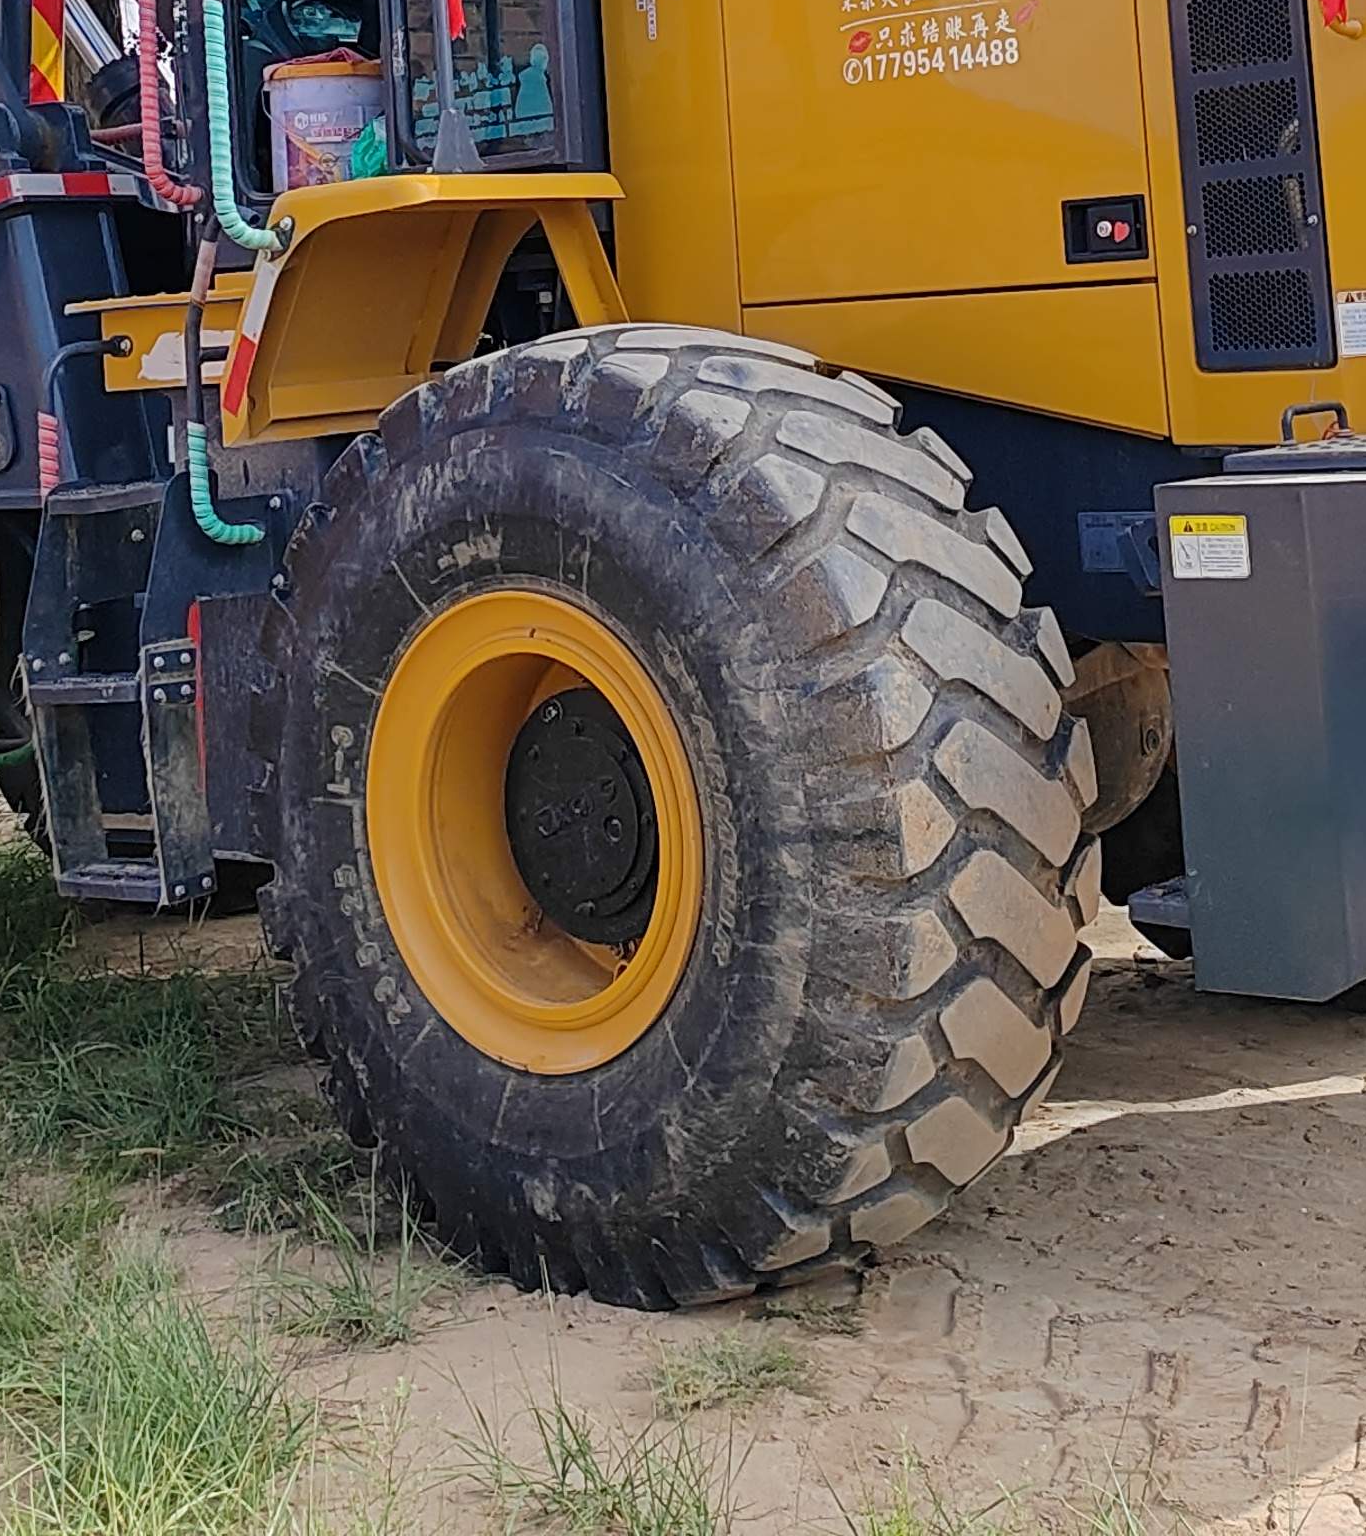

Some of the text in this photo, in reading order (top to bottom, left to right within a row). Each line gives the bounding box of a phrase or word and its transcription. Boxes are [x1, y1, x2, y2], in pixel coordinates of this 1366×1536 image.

[875, 7, 1017, 50] 只求结账再走
[863, 36, 1020, 83] 17795414488
